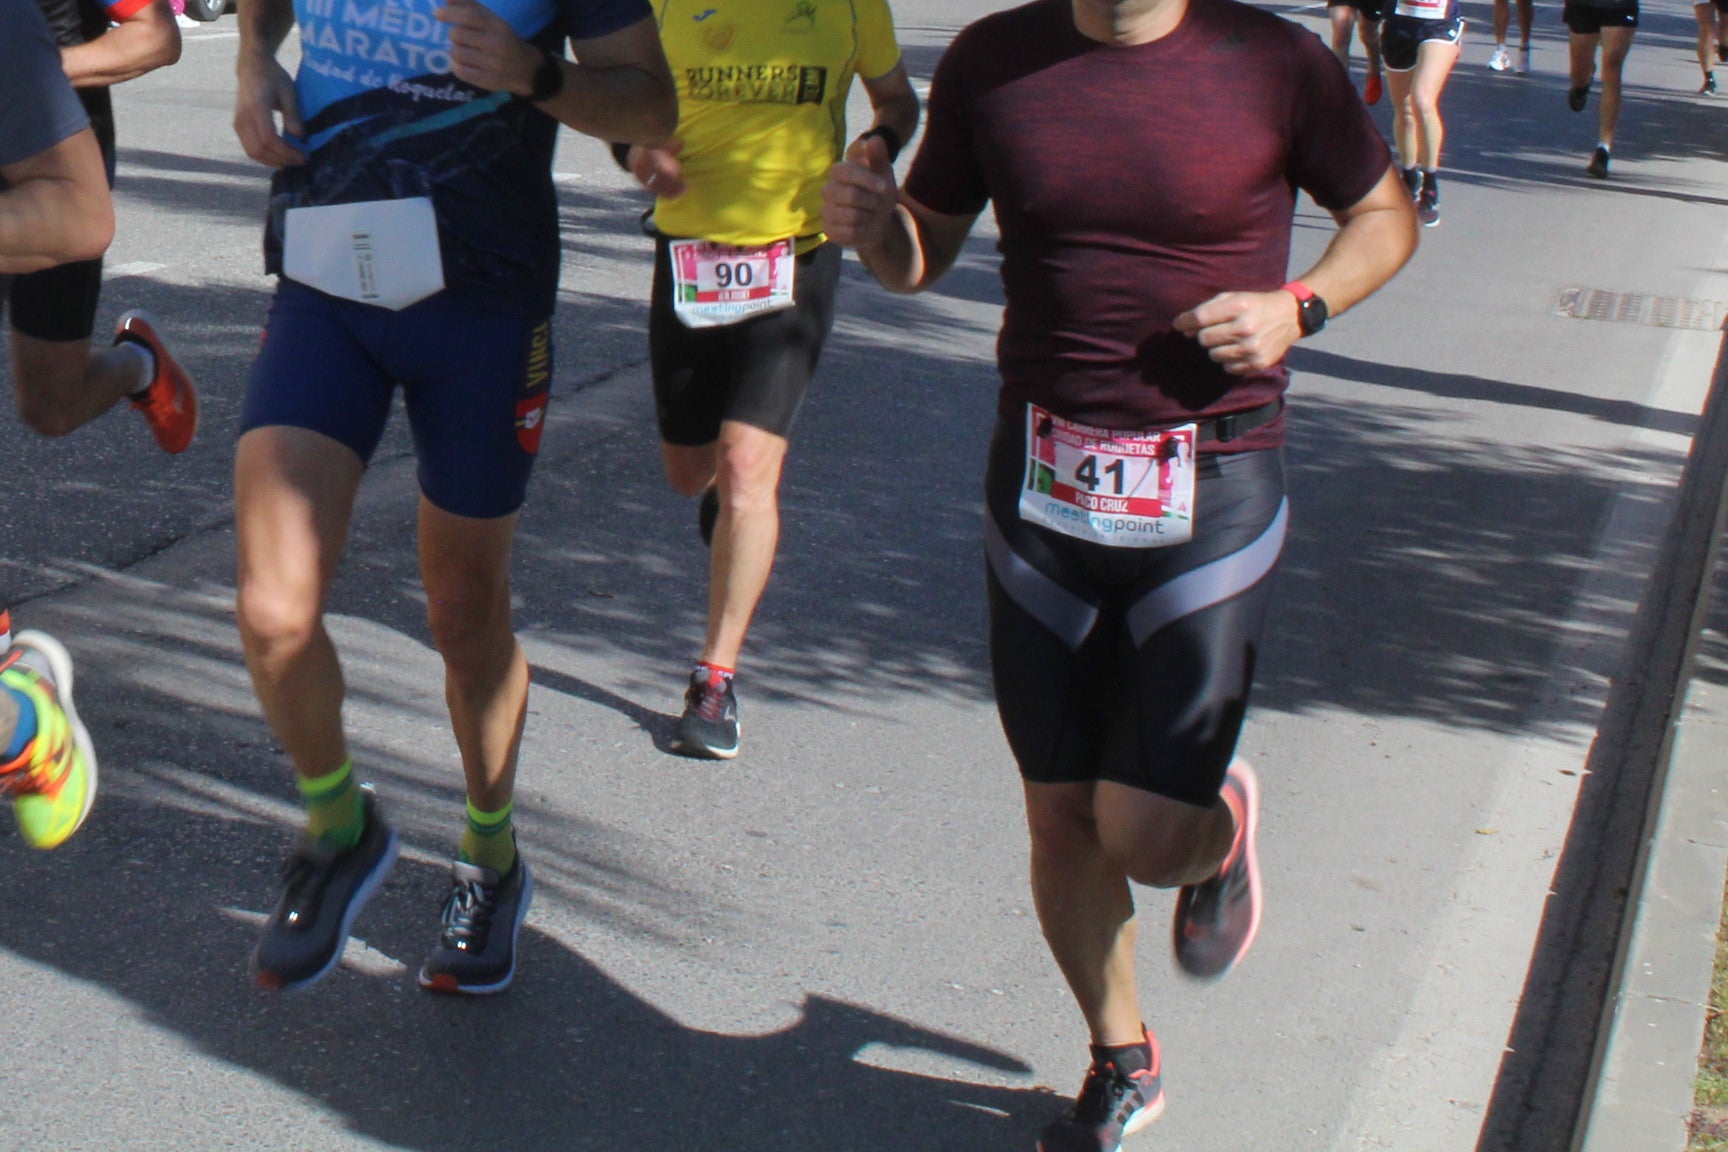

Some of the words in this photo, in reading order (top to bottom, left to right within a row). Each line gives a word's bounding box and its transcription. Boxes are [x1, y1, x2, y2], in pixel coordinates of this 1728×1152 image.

[686, 64, 798, 84] RUNNERS
[715, 262, 752, 288] 90
[1075, 453, 1125, 496] 41
[1100, 497, 1129, 513] CRUZ
